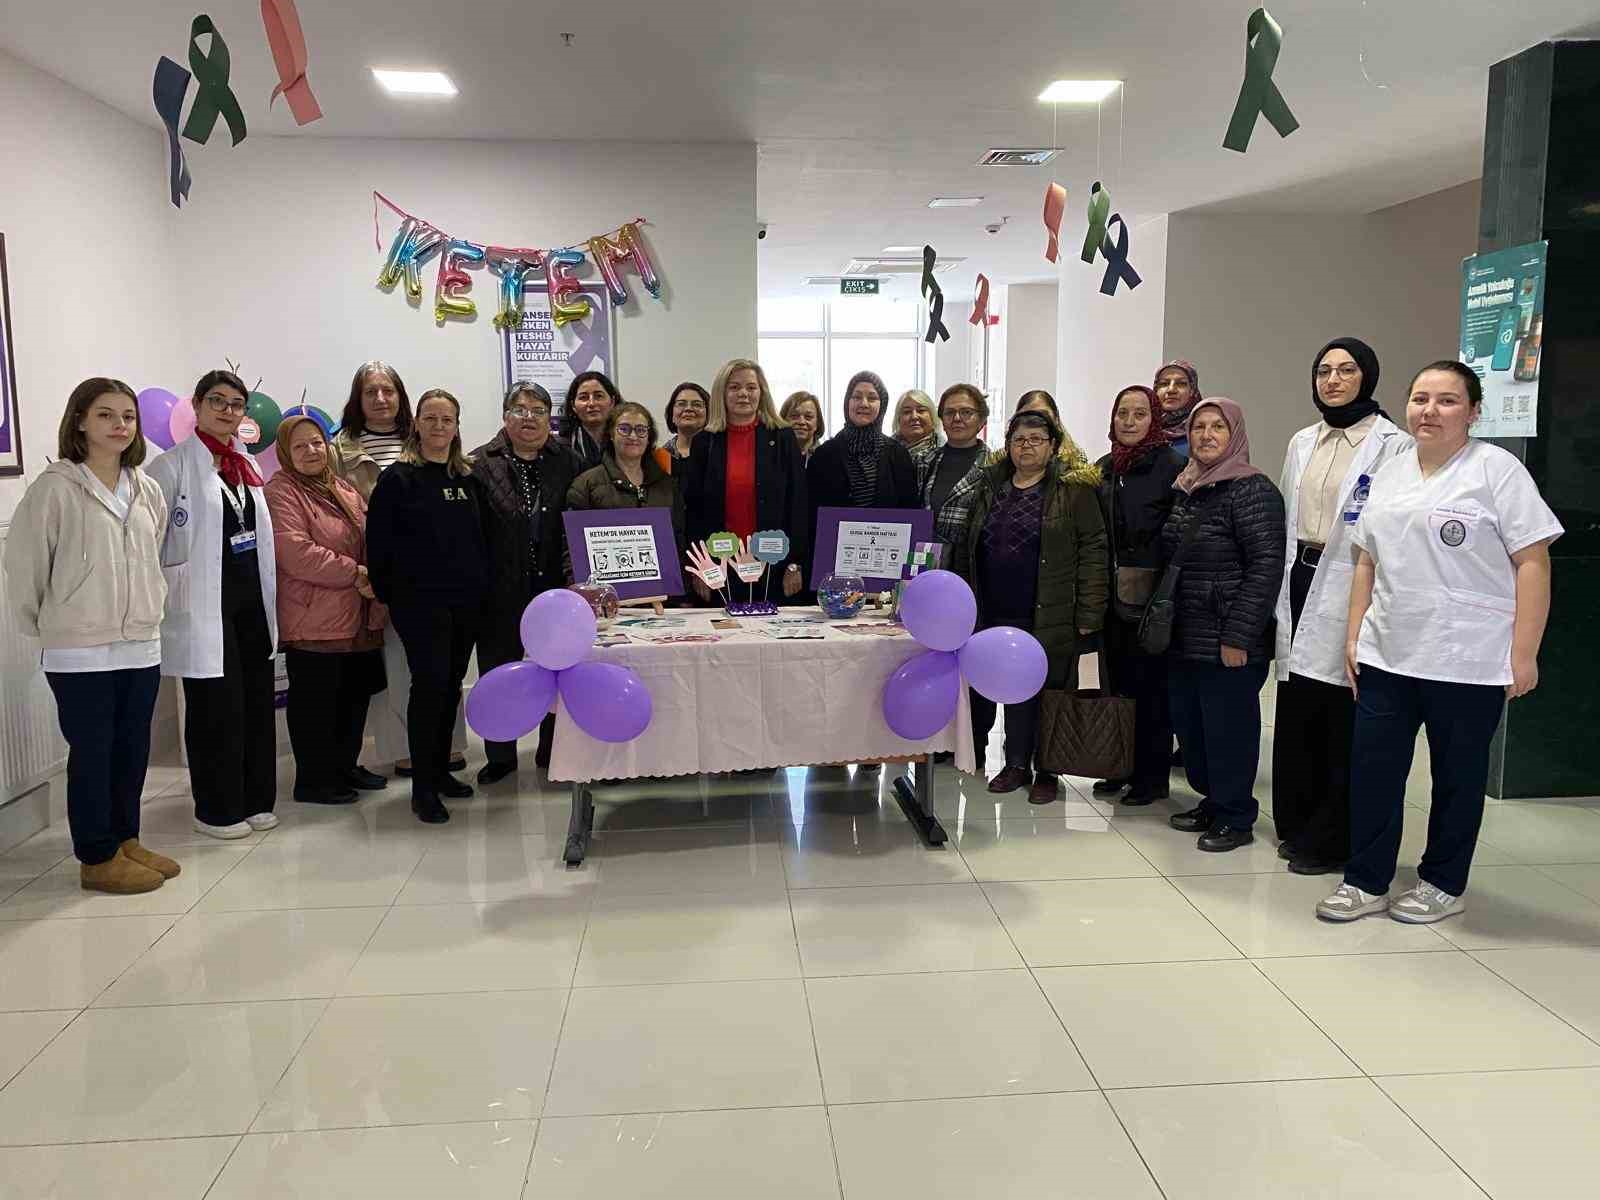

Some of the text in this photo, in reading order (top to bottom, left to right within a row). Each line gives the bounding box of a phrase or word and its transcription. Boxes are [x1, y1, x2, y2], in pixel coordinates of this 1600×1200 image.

[376, 217, 661, 328] KETEM
[520, 311, 552, 319] ANSE
[517, 322, 549, 330] RKEN
[517, 342, 551, 351] HAYAT
[517, 352, 569, 361] KURTARIR
